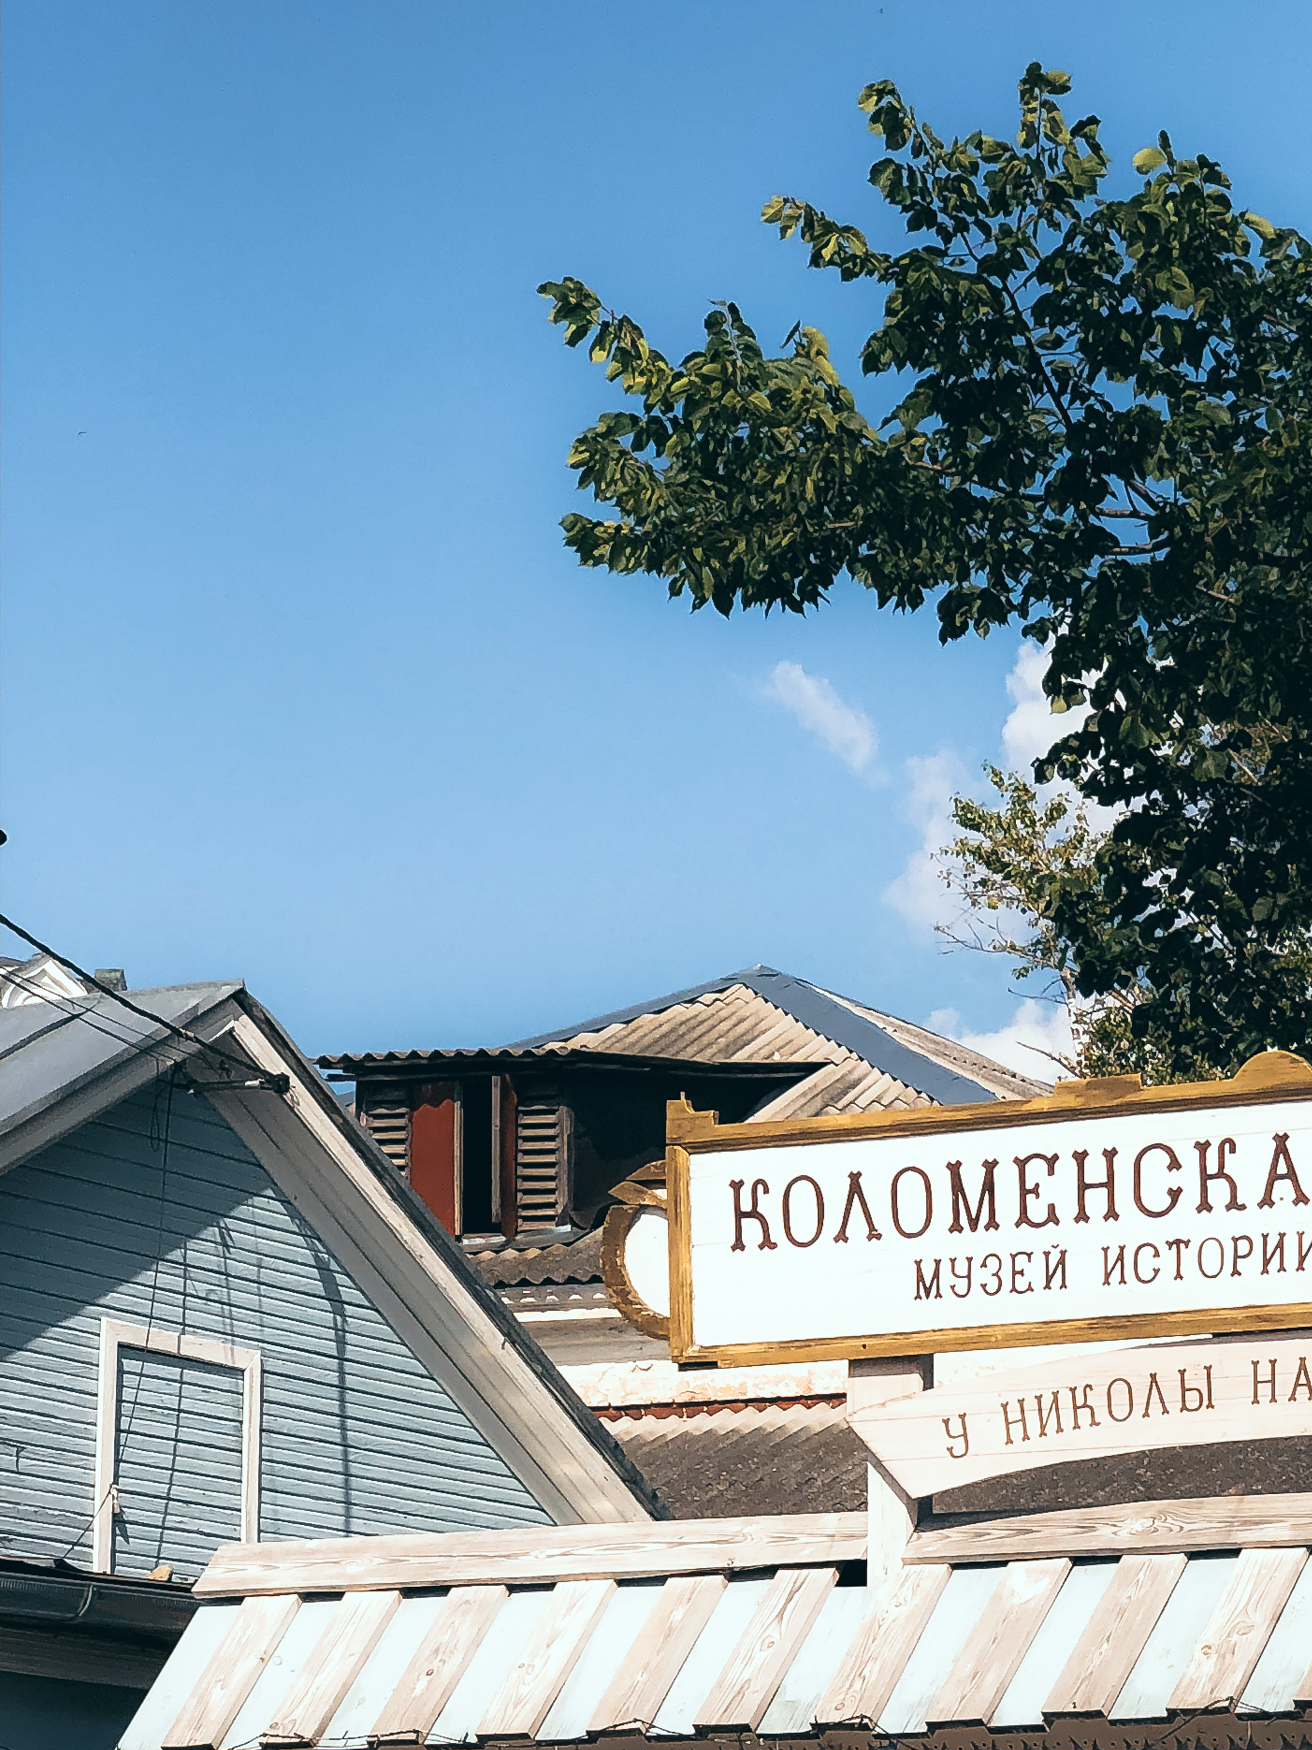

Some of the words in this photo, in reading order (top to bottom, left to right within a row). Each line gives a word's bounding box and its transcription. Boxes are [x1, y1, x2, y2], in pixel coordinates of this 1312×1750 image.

[914, 1244, 1067, 1300] МУЗЕЙ
[942, 1413, 971, 1459] У
[1000, 1365, 1215, 1446] НИКОЛЫ
